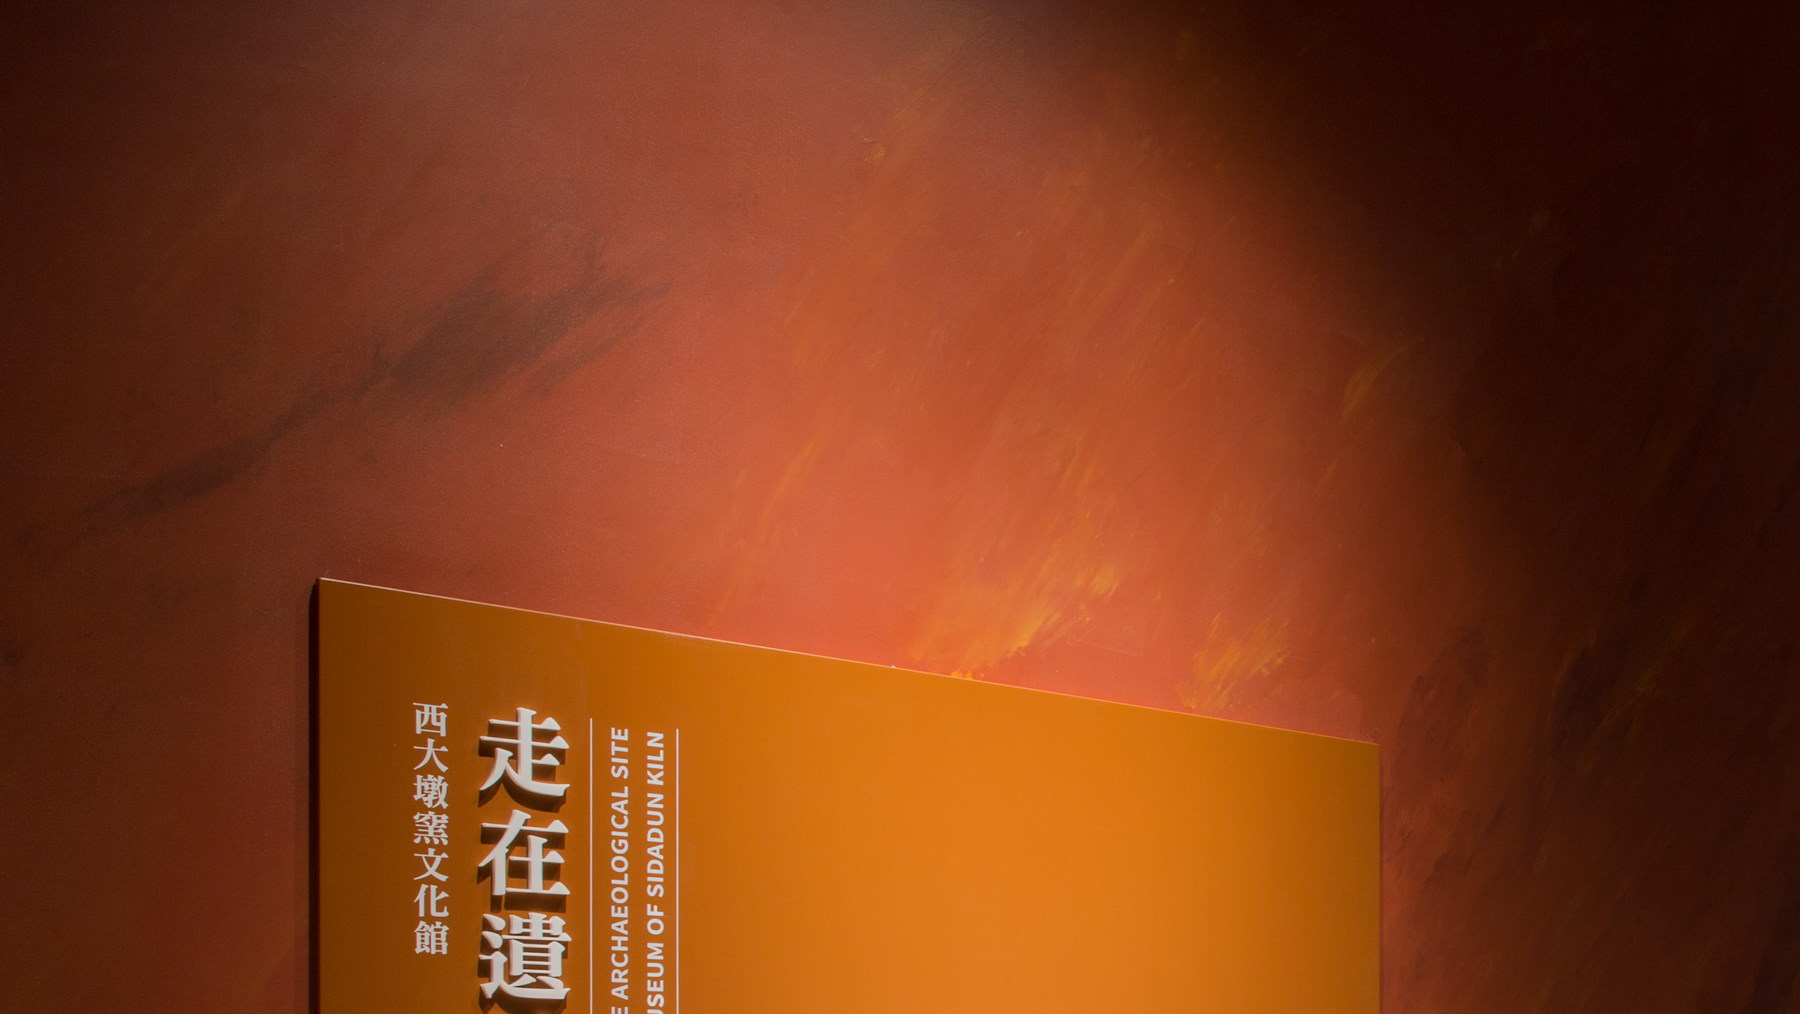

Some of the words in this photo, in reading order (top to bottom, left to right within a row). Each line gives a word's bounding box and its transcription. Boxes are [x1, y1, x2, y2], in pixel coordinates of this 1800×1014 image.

[611, 727, 629, 780] SITE
[647, 732, 665, 785] KILN
[413, 702, 449, 955] 西大墩窯文化館
[647, 793, 665, 898] SIDADUN
[611, 786, 629, 1000] ARCHAEOLOGICAL
[647, 904, 665, 936] OF
